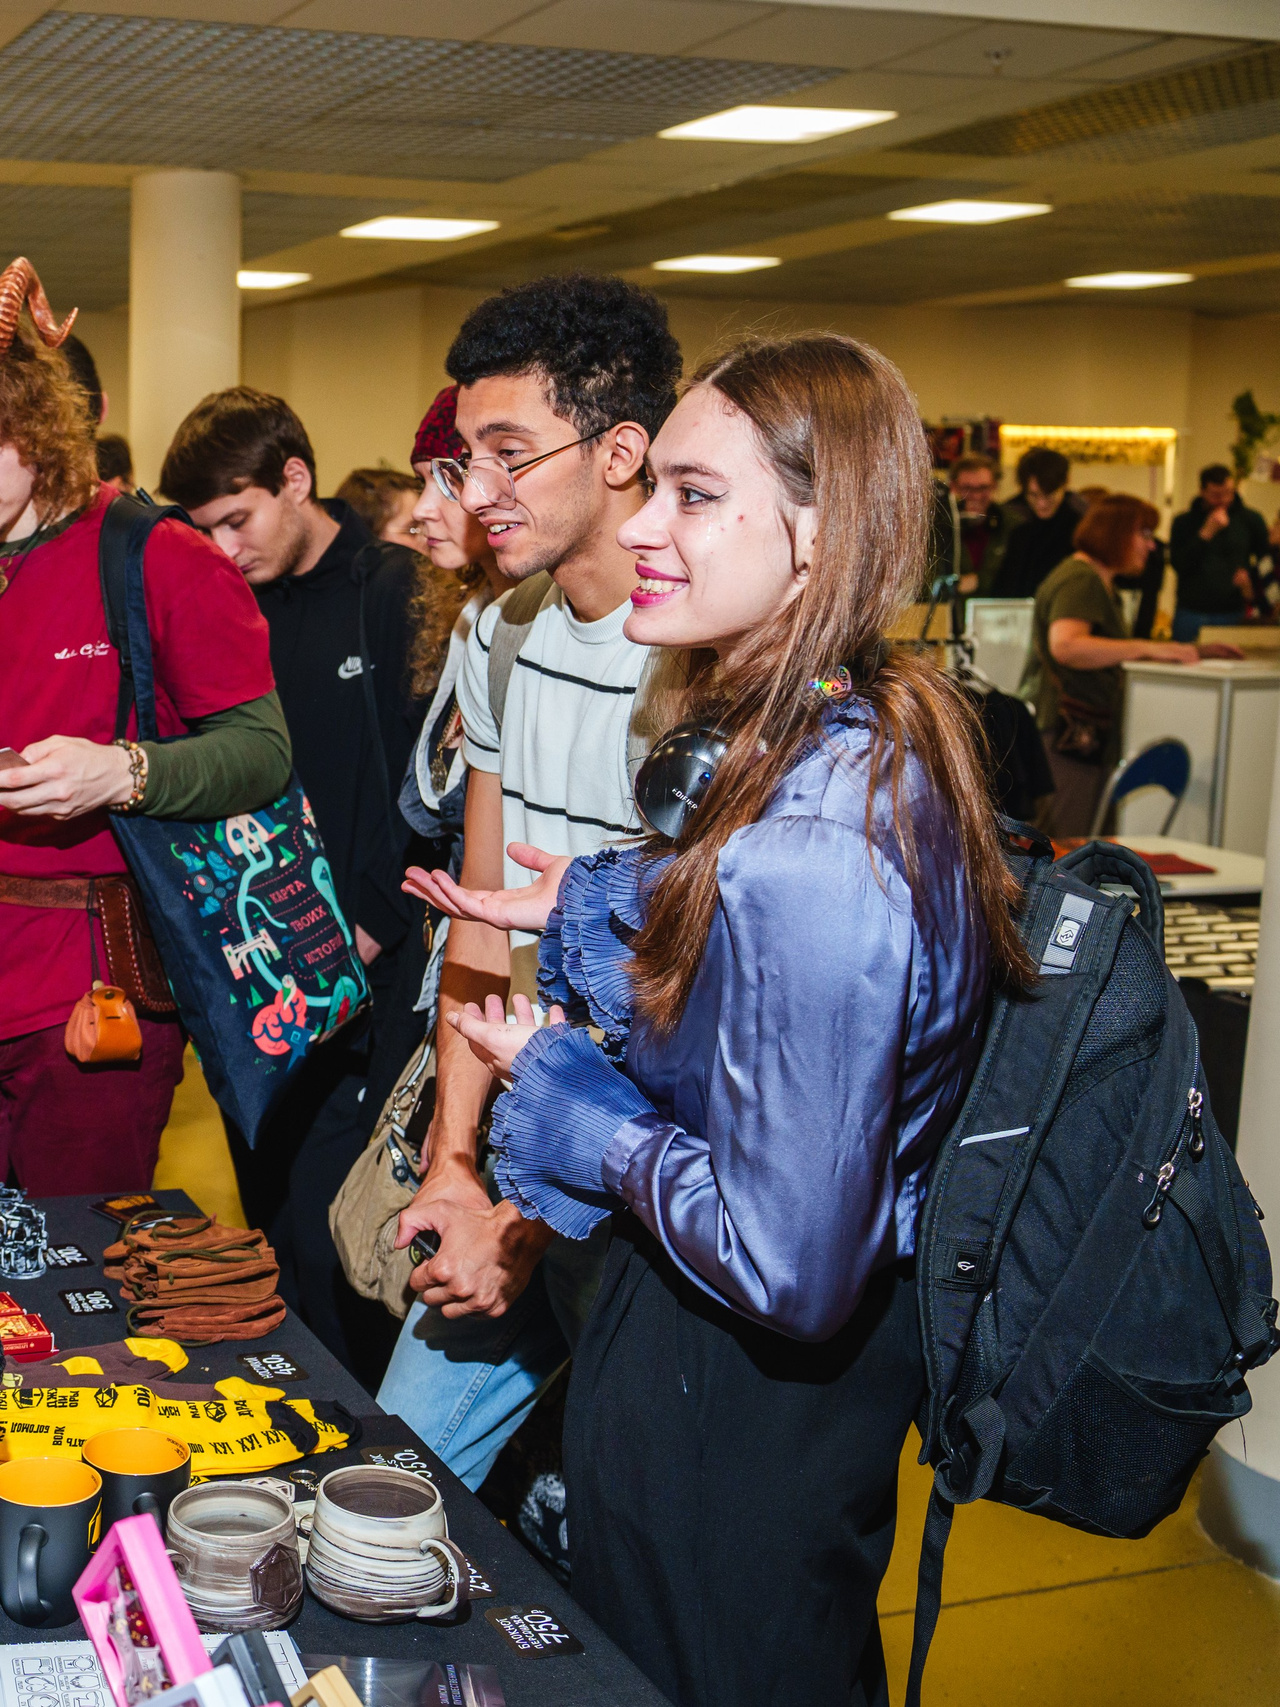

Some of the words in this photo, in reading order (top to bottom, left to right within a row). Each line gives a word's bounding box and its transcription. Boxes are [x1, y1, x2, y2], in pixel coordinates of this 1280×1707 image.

[269, 880, 307, 904] КАРТА
[290, 905, 327, 932] ТВОИХ
[58, 1395, 68, 1408] НИ
[69, 1390, 80, 1408] ОРЫ
[133, 1387, 151, 1408] ОЙ
[10, 1421, 51, 1434] БОГОМОЛ
[52, 1426, 66, 1446] ВОЛК
[209, 1442, 234, 1455] ХУ!
[236, 1433, 262, 1453] ХУ!
[495, 1618, 531, 1650] БЛОКНОТ
[510, 1614, 544, 1650] ПЕРСОНАЖА
